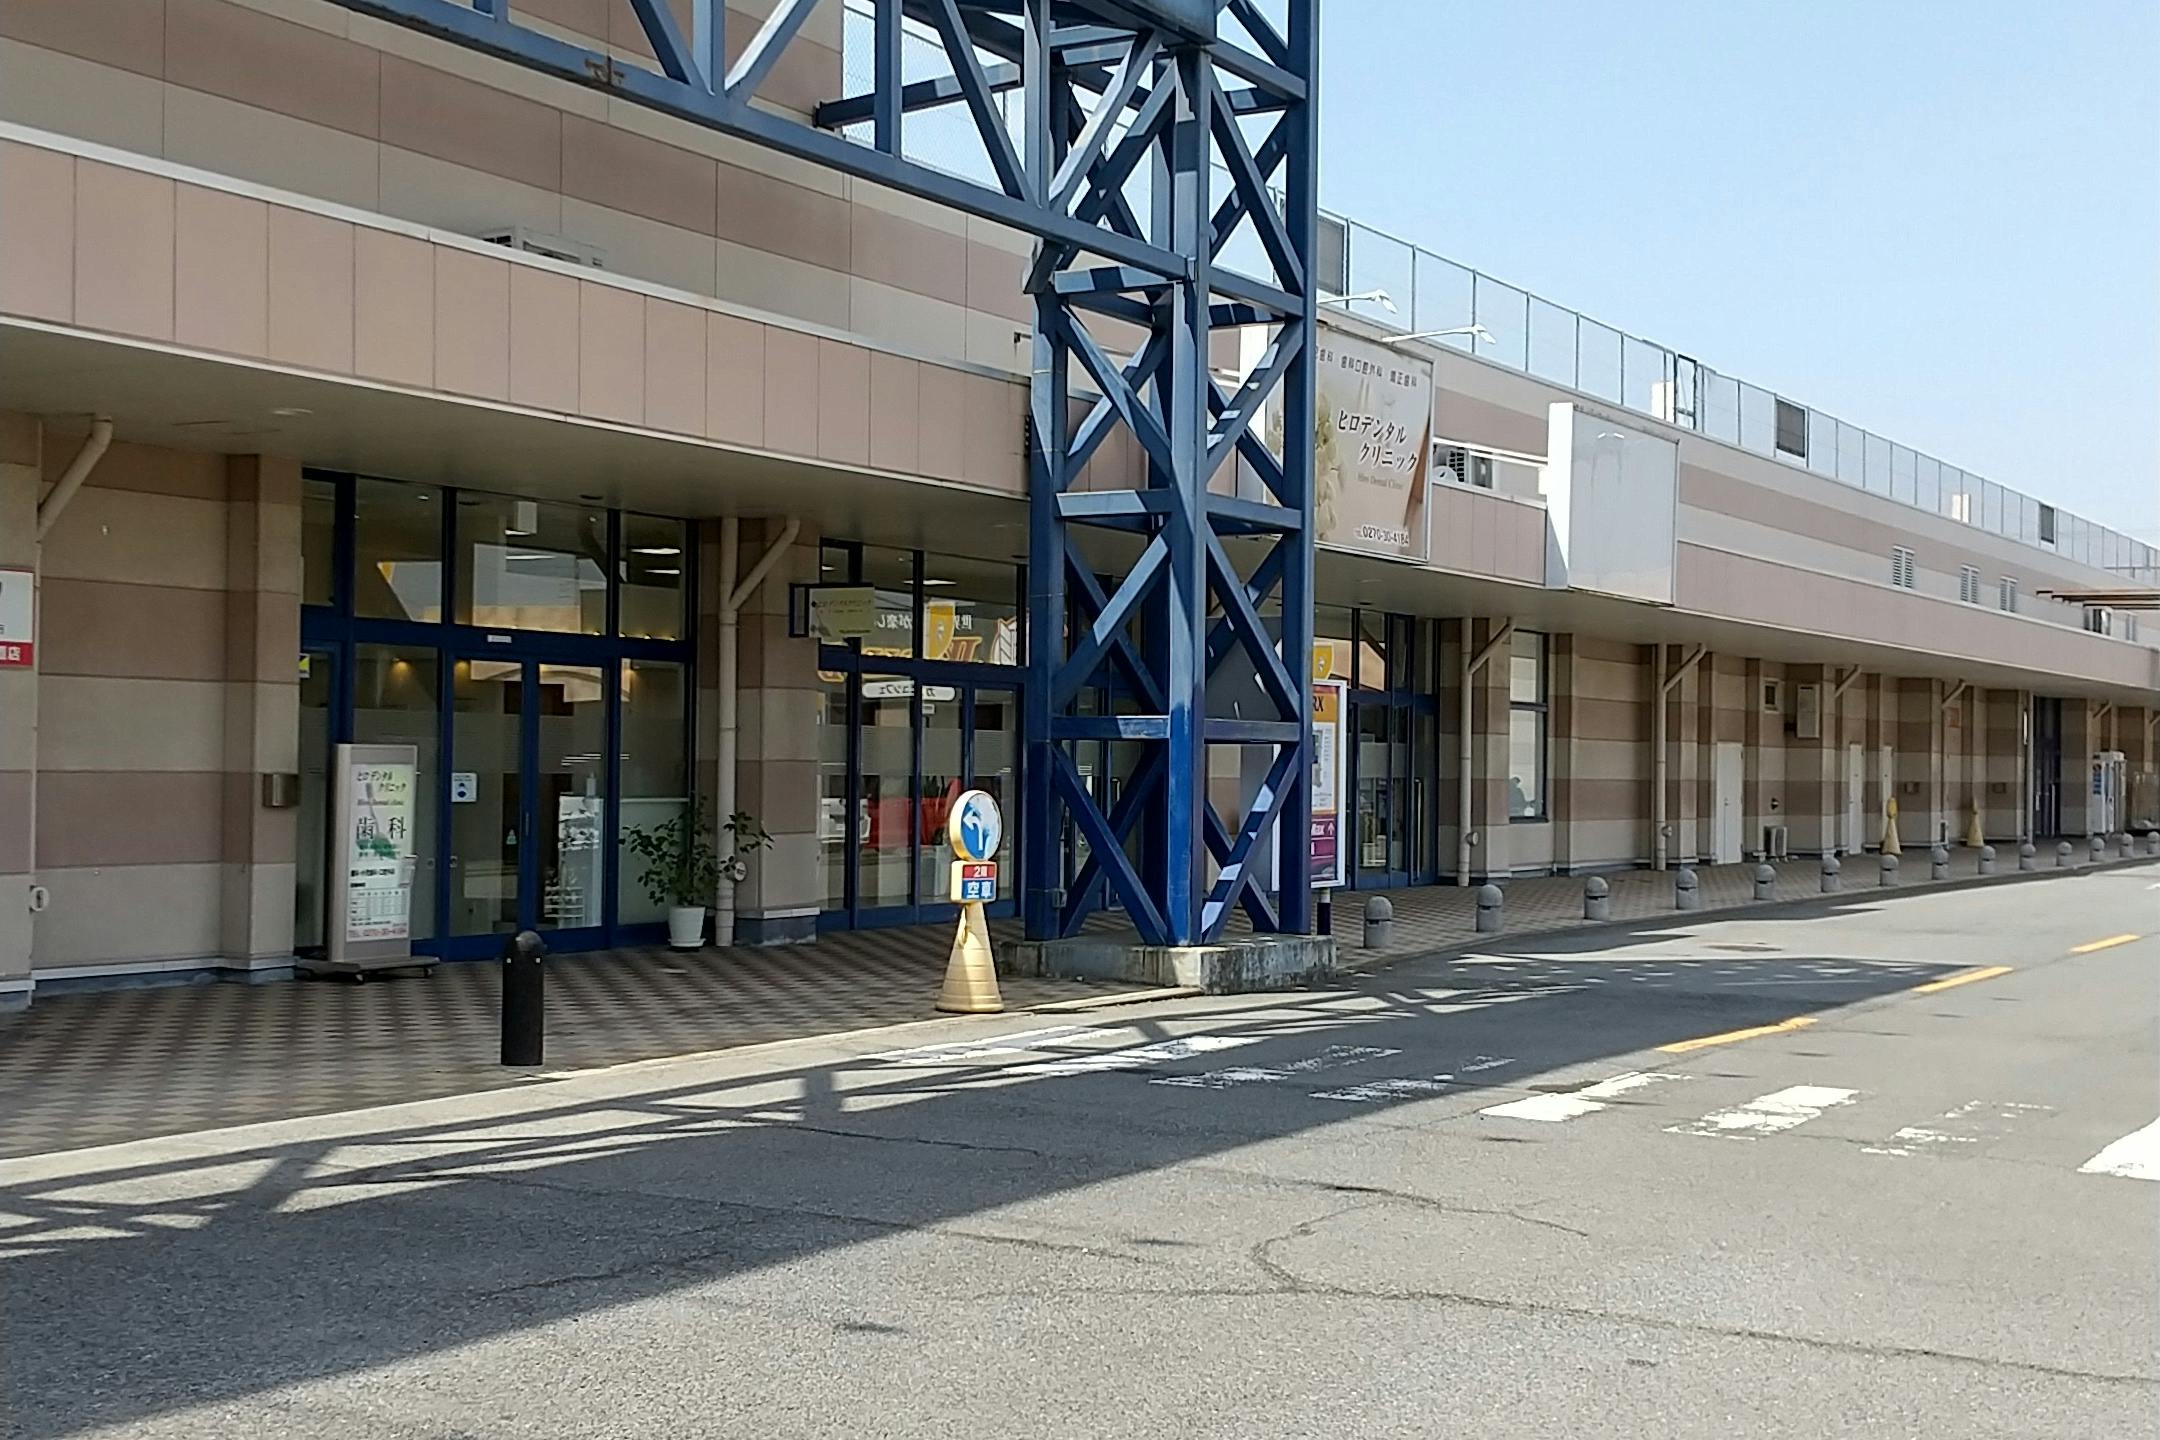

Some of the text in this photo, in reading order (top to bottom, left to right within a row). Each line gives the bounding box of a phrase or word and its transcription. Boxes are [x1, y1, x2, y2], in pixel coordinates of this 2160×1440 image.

[1338, 410, 1407, 444] ヒロデンタル
[1360, 442, 1418, 472] クリニック
[966, 881, 993, 899] 空車
